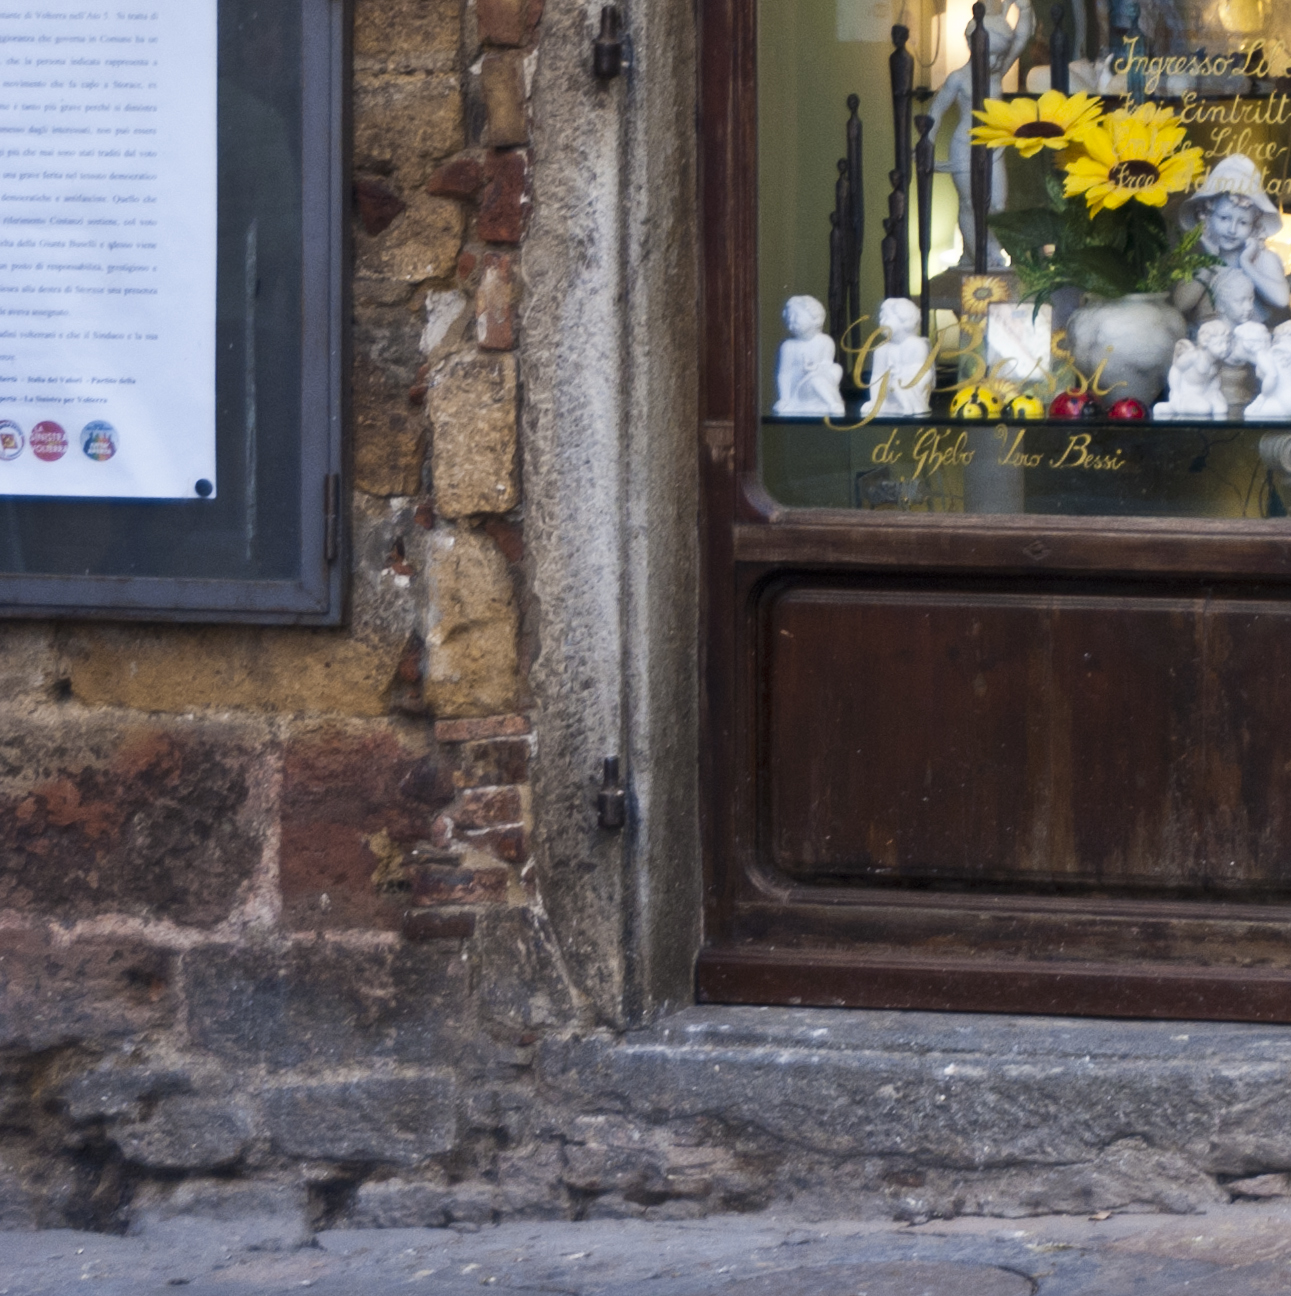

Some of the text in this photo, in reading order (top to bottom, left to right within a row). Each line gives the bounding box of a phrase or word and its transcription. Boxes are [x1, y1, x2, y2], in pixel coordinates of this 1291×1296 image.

[1114, 35, 1235, 95] Ingresso
[1204, 126, 1288, 161] Libre
[1110, 160, 1156, 194] Free
[871, 427, 903, 465] di
[1049, 432, 1128, 471] Bessi
